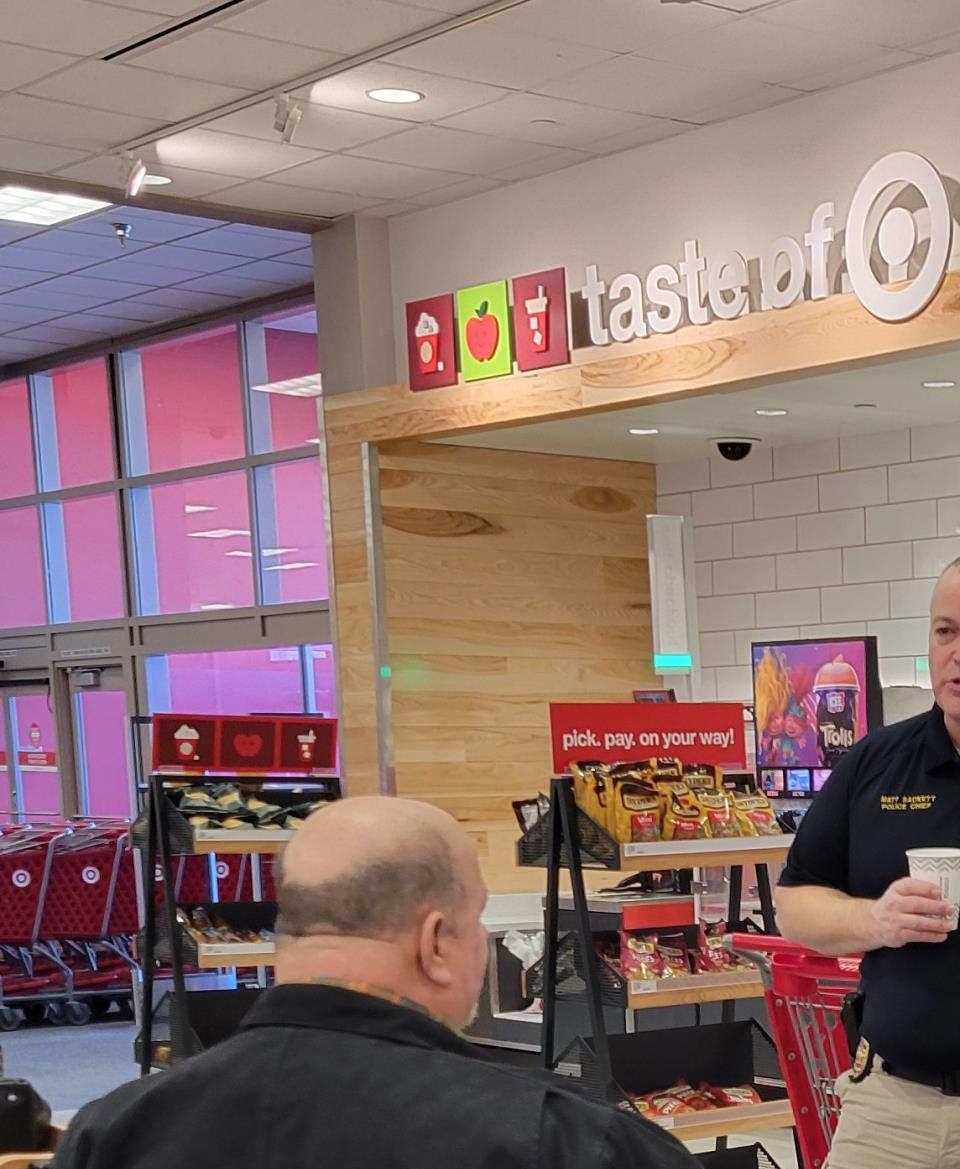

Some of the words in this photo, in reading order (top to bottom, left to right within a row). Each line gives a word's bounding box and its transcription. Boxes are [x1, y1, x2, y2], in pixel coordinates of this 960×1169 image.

[581, 240, 748, 346] taste
[764, 201, 834, 310] of
[562, 729, 601, 751] pick.
[604, 732, 636, 750] pay.
[639, 732, 659, 746] on
[662, 731, 697, 749] your
[700, 728, 735, 748] way!
